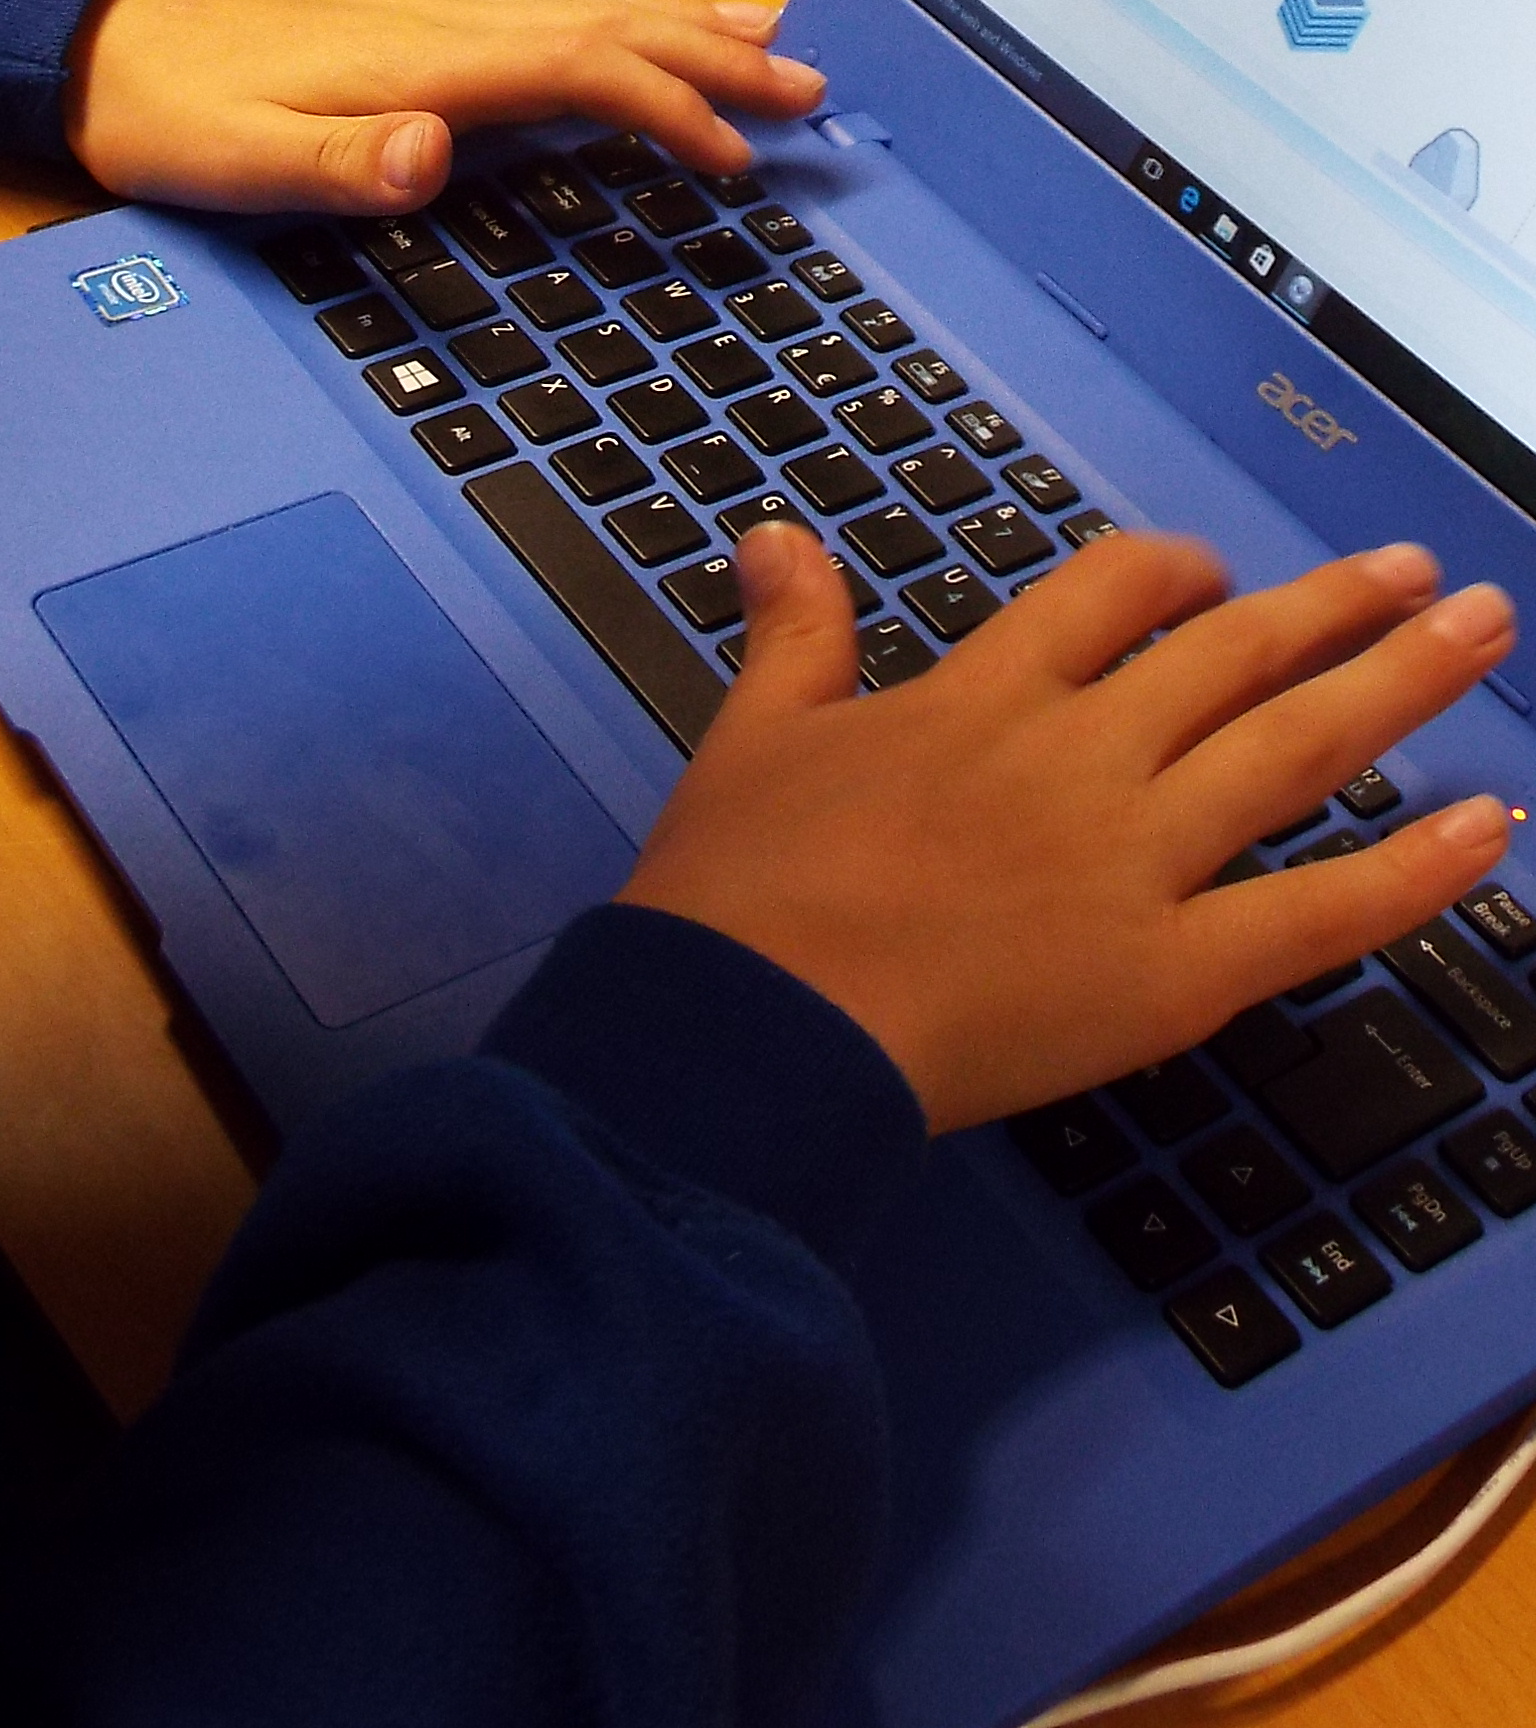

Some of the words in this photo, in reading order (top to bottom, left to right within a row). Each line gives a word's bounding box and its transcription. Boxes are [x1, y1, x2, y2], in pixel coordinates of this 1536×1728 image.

[636, 191, 652, 201] 1
[485, 220, 510, 240] Lock
[614, 230, 635, 244] Q
[684, 240, 702, 252] 2
[828, 262, 847, 276] F3
[546, 272, 570, 285] A
[664, 280, 692, 299] W
[734, 292, 755, 304] 3
[878, 310, 898, 325] F4
[491, 323, 515, 337] Z
[597, 323, 621, 337] S
[714, 334, 737, 348] E
[791, 348, 809, 359] 4
[930, 361, 950, 375] F5
[541, 378, 568, 394] X
[649, 378, 673, 392] D
[768, 389, 792, 404] R
[843, 400, 864, 413] 5
[1257, 371, 1358, 450] acer
[984, 413, 1004, 428] F6
[450, 426, 473, 442] Alt
[703, 434, 727, 447] F
[594, 437, 619, 452] C
[825, 447, 850, 461] T
[902, 459, 924, 472] 6
[1040, 468, 1061, 482] F7
[650, 495, 675, 510] V
[761, 495, 785, 512] G
[884, 506, 907, 521] Y
[961, 519, 983, 532] 7
[704, 557, 729, 574] B
[944, 567, 969, 584] U
[878, 623, 902, 635] J
[1492, 891, 1532, 928] Pause
[1473, 901, 1511, 937] Break
[1447, 967, 1512, 1030] Backspace
[1395, 1055, 1434, 1090] Enter
[1493, 1130, 1533, 1171] PgUp
[1408, 1182, 1448, 1223] PgDn
[1321, 1240, 1356, 1273] End
